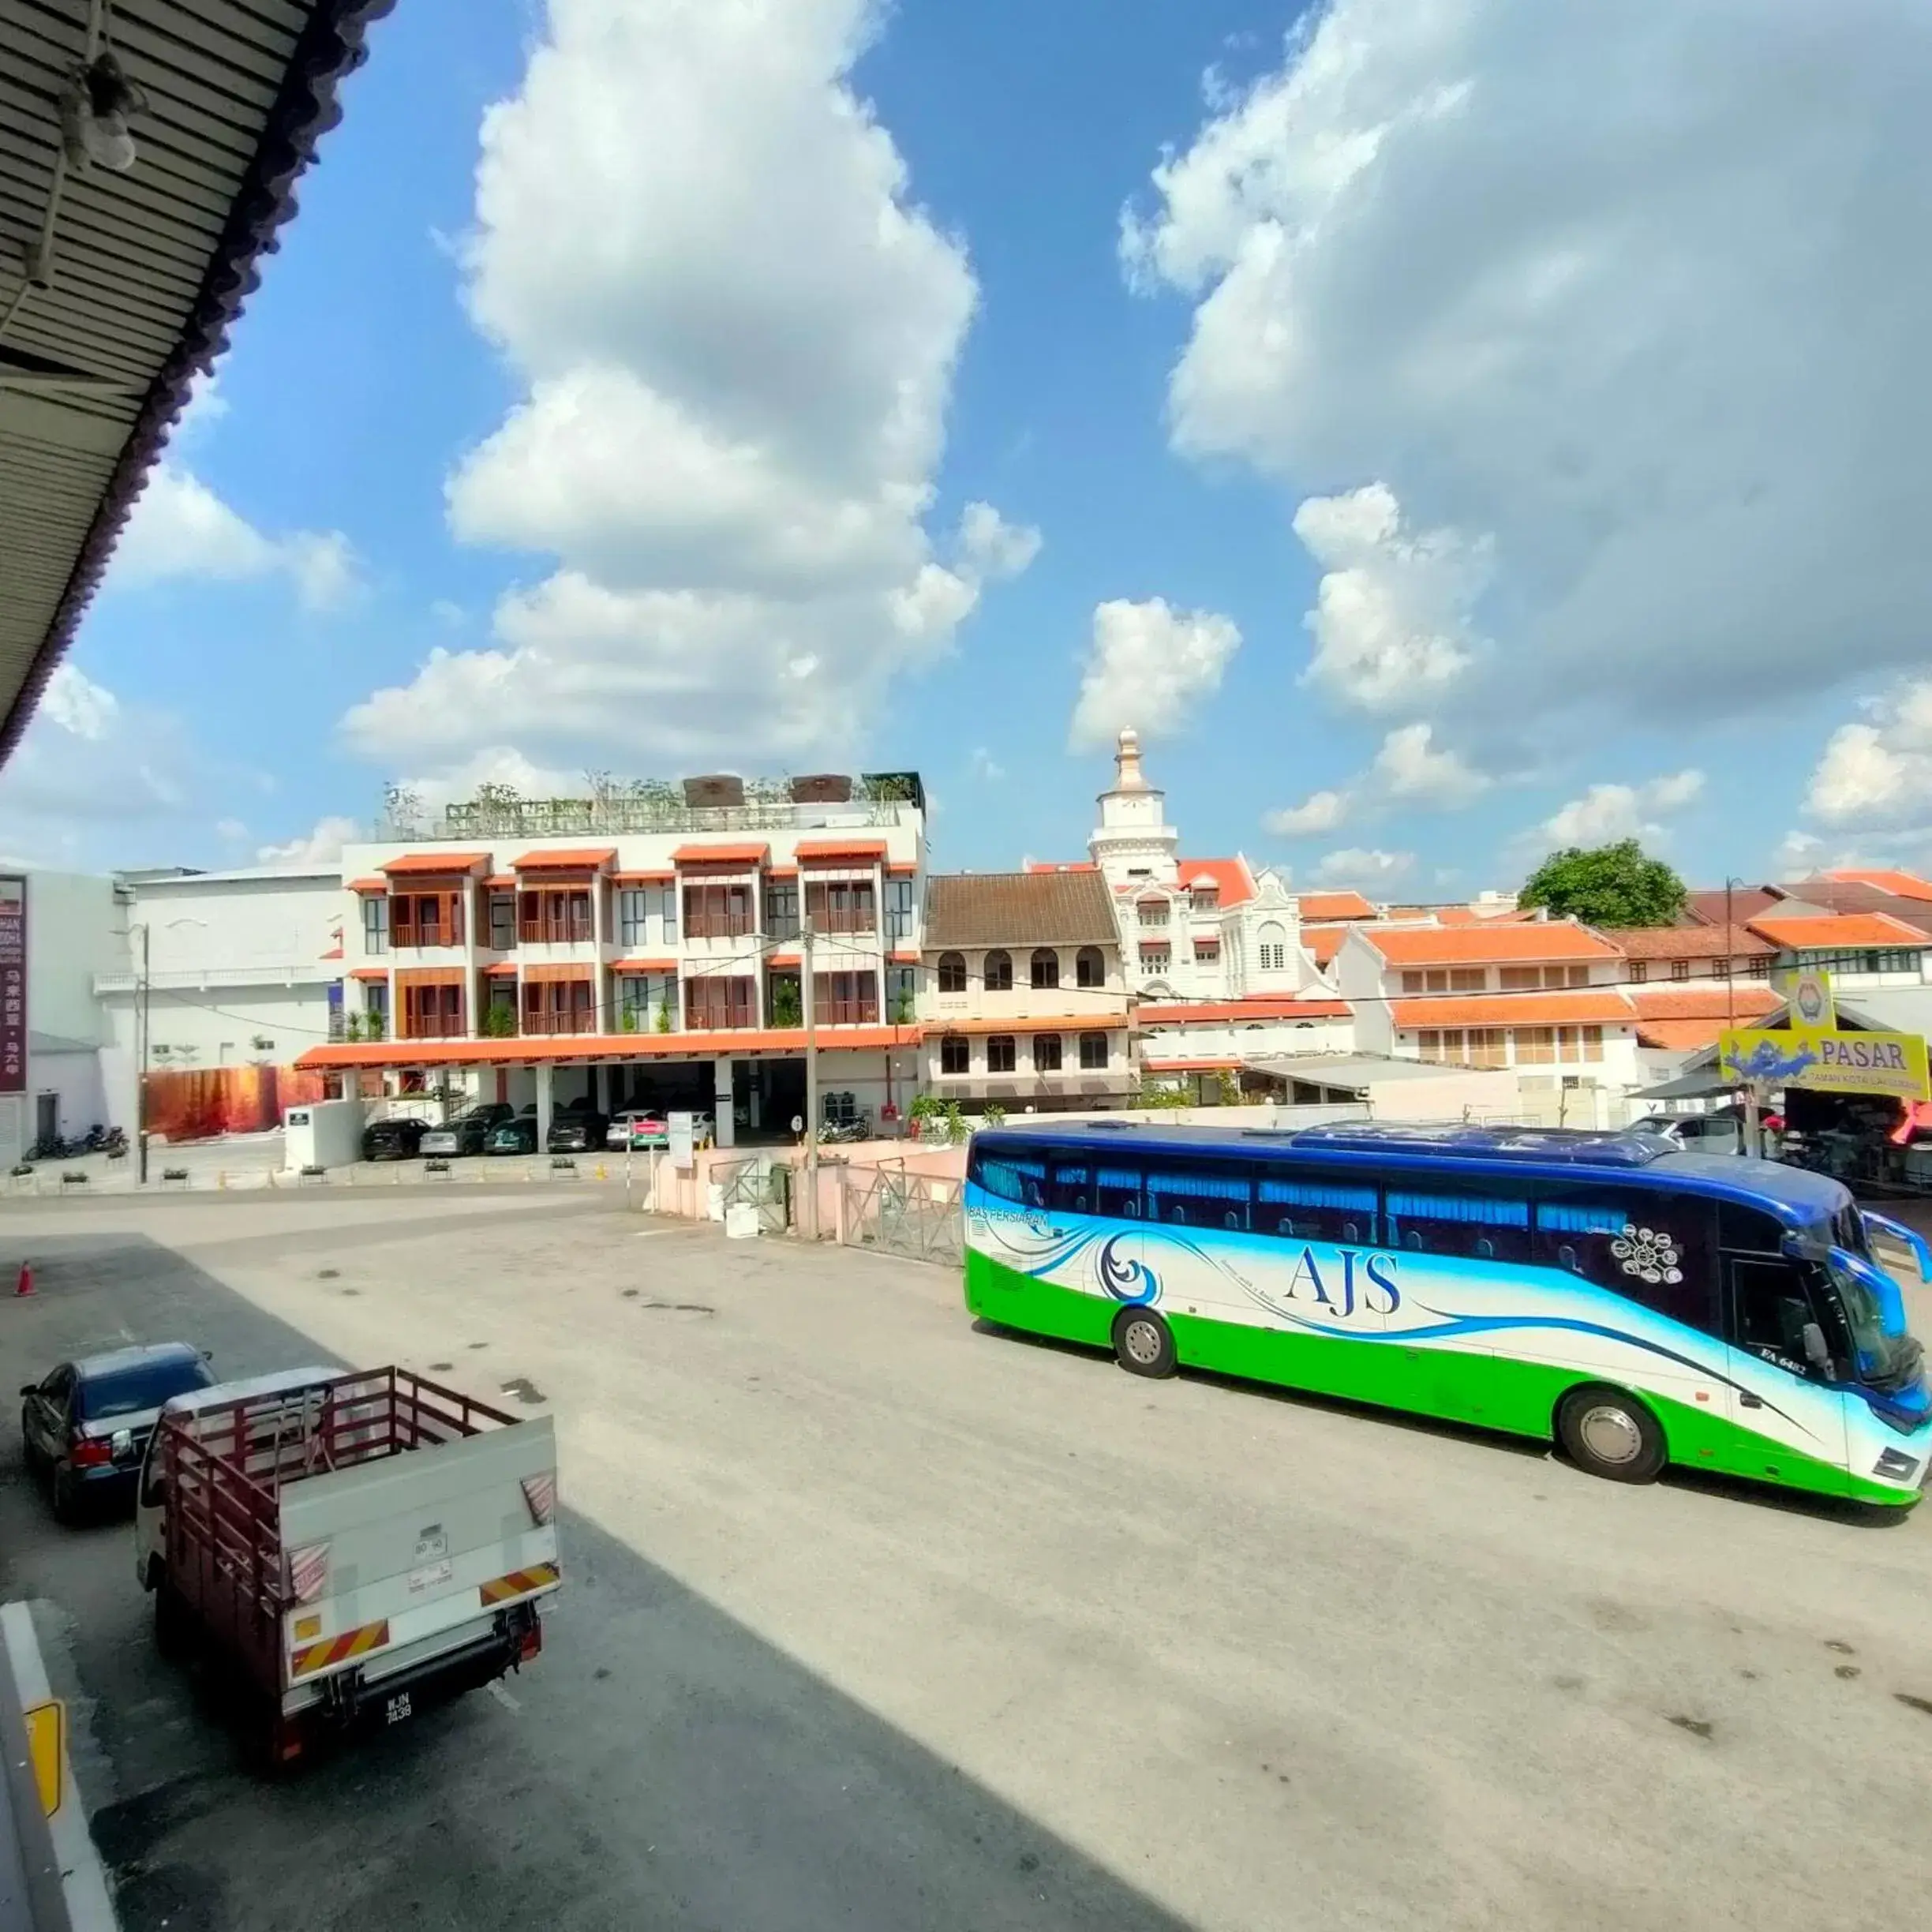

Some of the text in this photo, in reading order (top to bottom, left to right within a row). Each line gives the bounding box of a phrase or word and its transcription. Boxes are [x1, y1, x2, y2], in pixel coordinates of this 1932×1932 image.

[1821, 1040, 1907, 1070] PASAR
[968, 1206, 988, 1219] BAS
[1282, 1246, 1401, 1317] AJS
